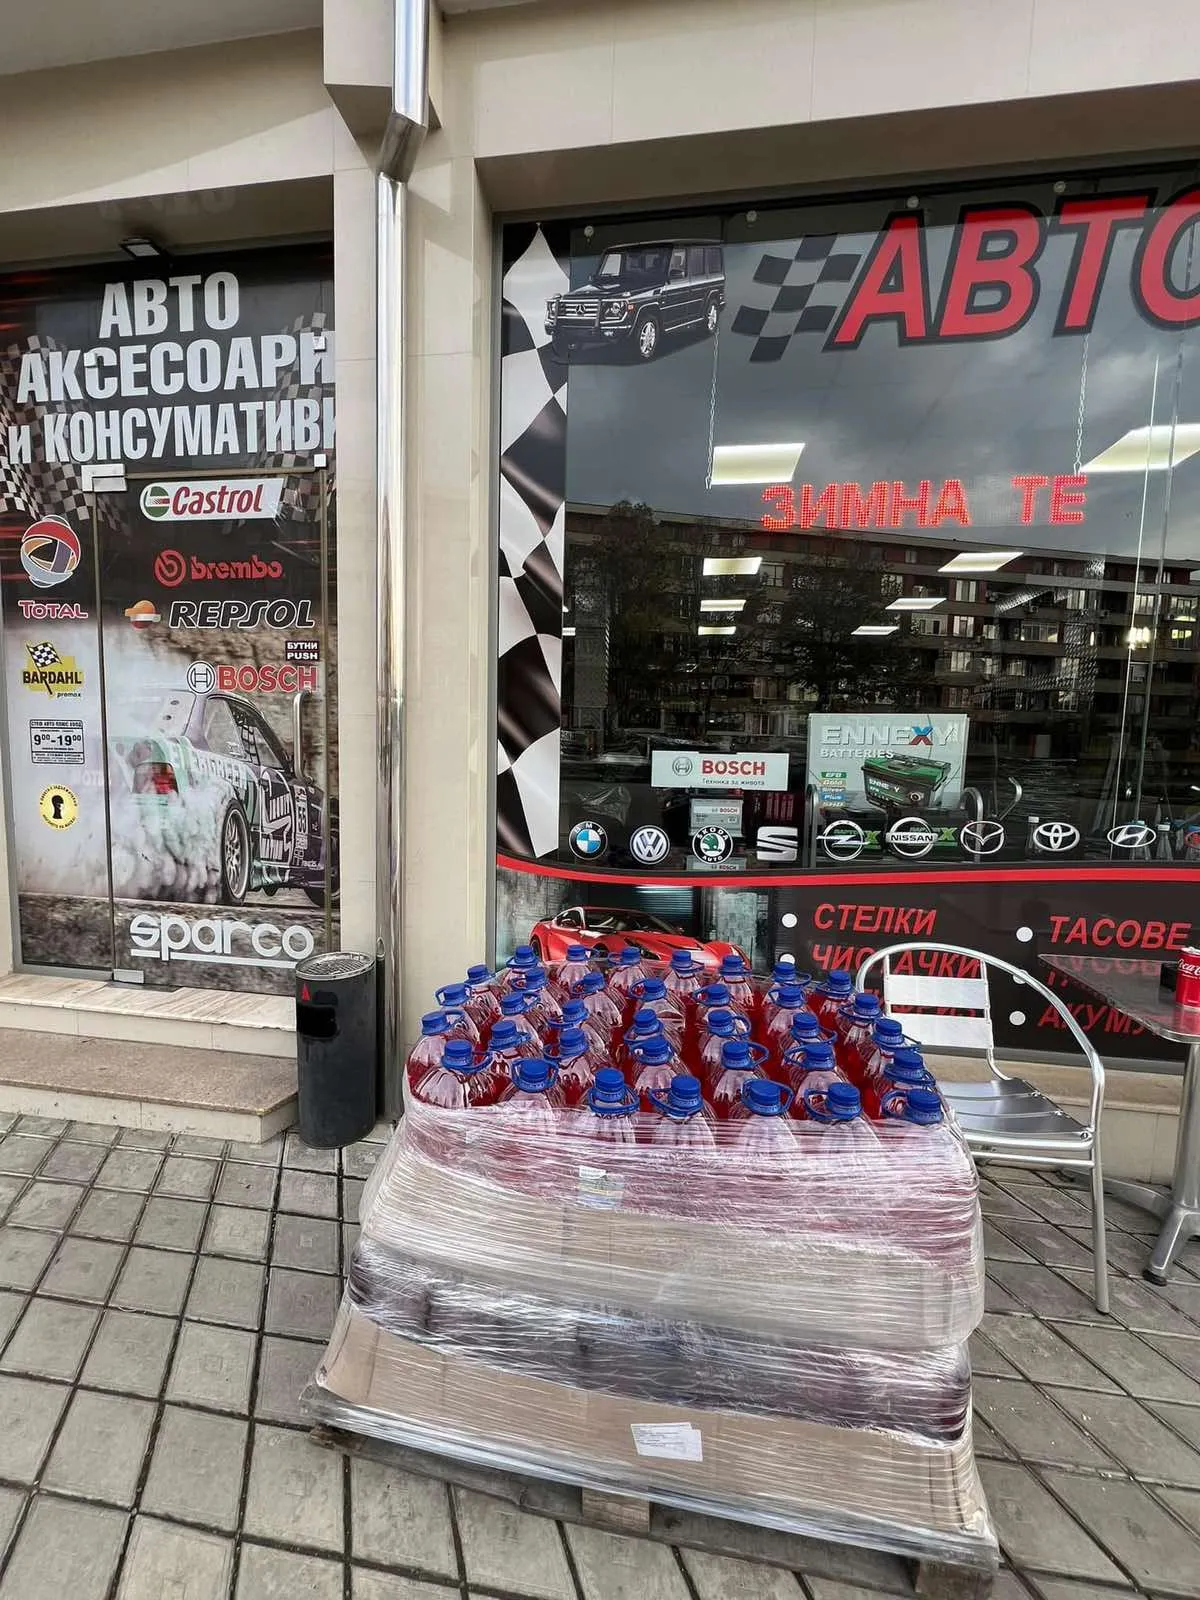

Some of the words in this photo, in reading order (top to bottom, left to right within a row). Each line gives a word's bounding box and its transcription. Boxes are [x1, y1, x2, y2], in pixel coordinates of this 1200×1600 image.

[828, 185, 1200, 346] АВТО
[99, 271, 240, 339] АВТО
[17, 330, 336, 404] АКСЕСОАРИ
[171, 484, 264, 515] Castrol
[761, 478, 970, 530] ЗИМНА
[1011, 474, 1088, 525] ТЕ
[191, 554, 284, 580] brembo
[18, 600, 89, 620] TOTAL
[168, 599, 315, 629] REPSOL
[286, 641, 318, 650] БУТНИ
[286, 652, 318, 660] PUSH
[22, 671, 82, 685] BARDAHL
[217, 664, 318, 692] BOSCH
[820, 725, 956, 746] ENNEXY
[819, 748, 894, 758] BATTERIES
[702, 760, 765, 776] BOSCH
[890, 834, 933, 842] NISSAN
[813, 903, 937, 936] СТЕЛКИ
[1049, 916, 1192, 950] ТАСОВЕ
[129, 913, 315, 960] sparco
[811, 943, 981, 979] ЧИСАЧКИ
